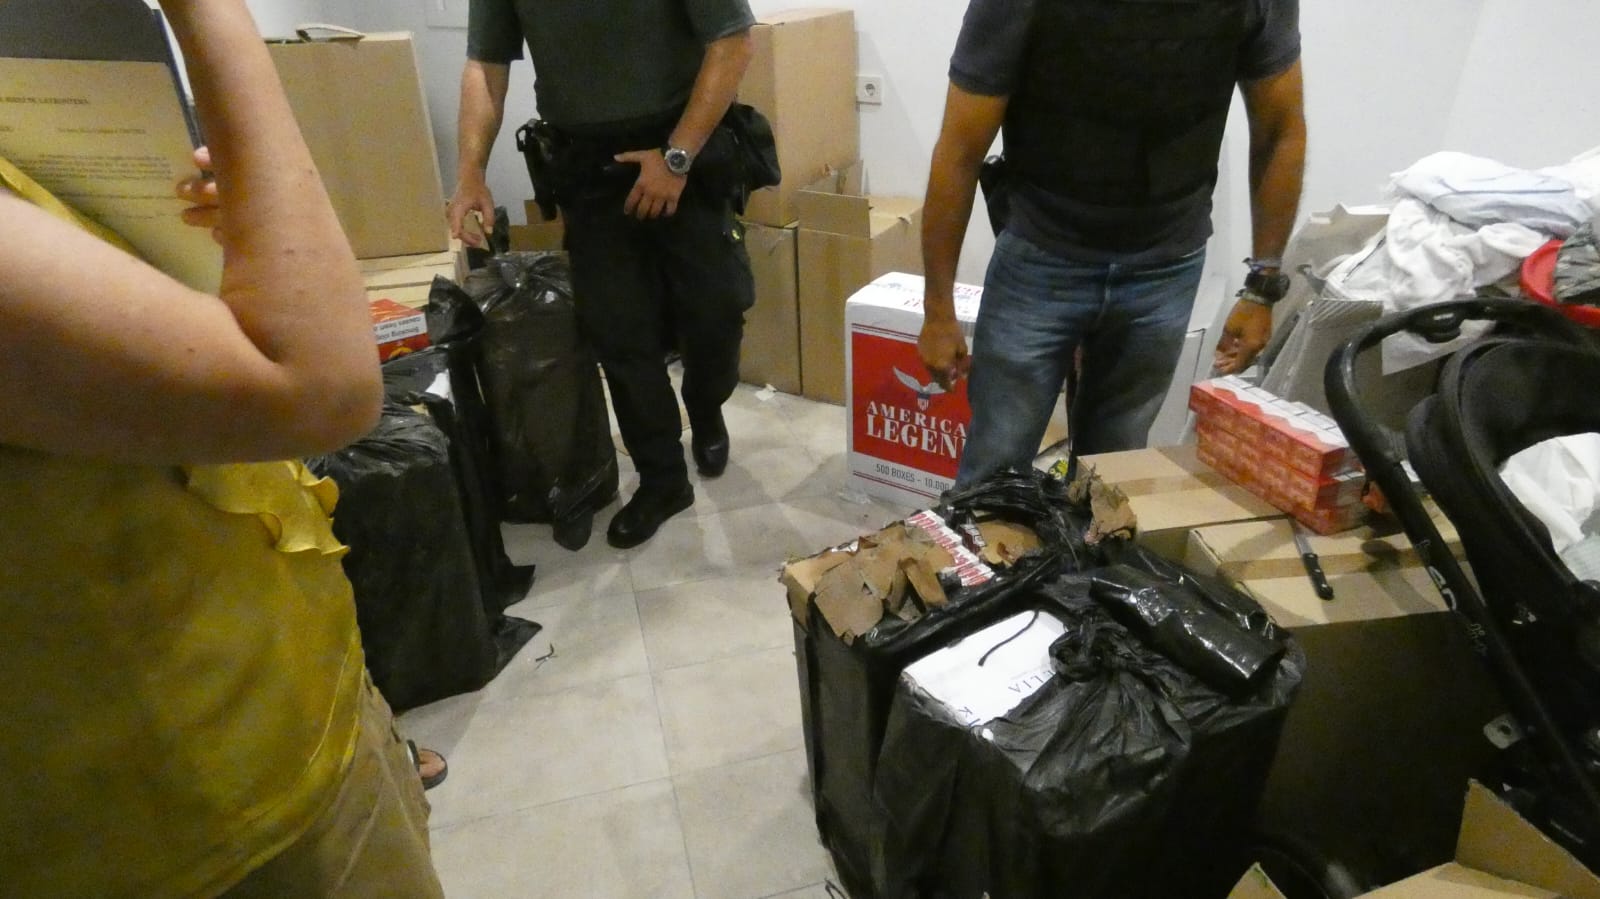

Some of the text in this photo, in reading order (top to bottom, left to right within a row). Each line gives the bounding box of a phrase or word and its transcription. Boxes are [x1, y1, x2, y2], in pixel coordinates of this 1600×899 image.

[866, 400, 967, 437] AMERICA
[866, 414, 967, 459] LEGEN
[876, 463, 890, 475] 500
[891, 467, 915, 482] BOXES
